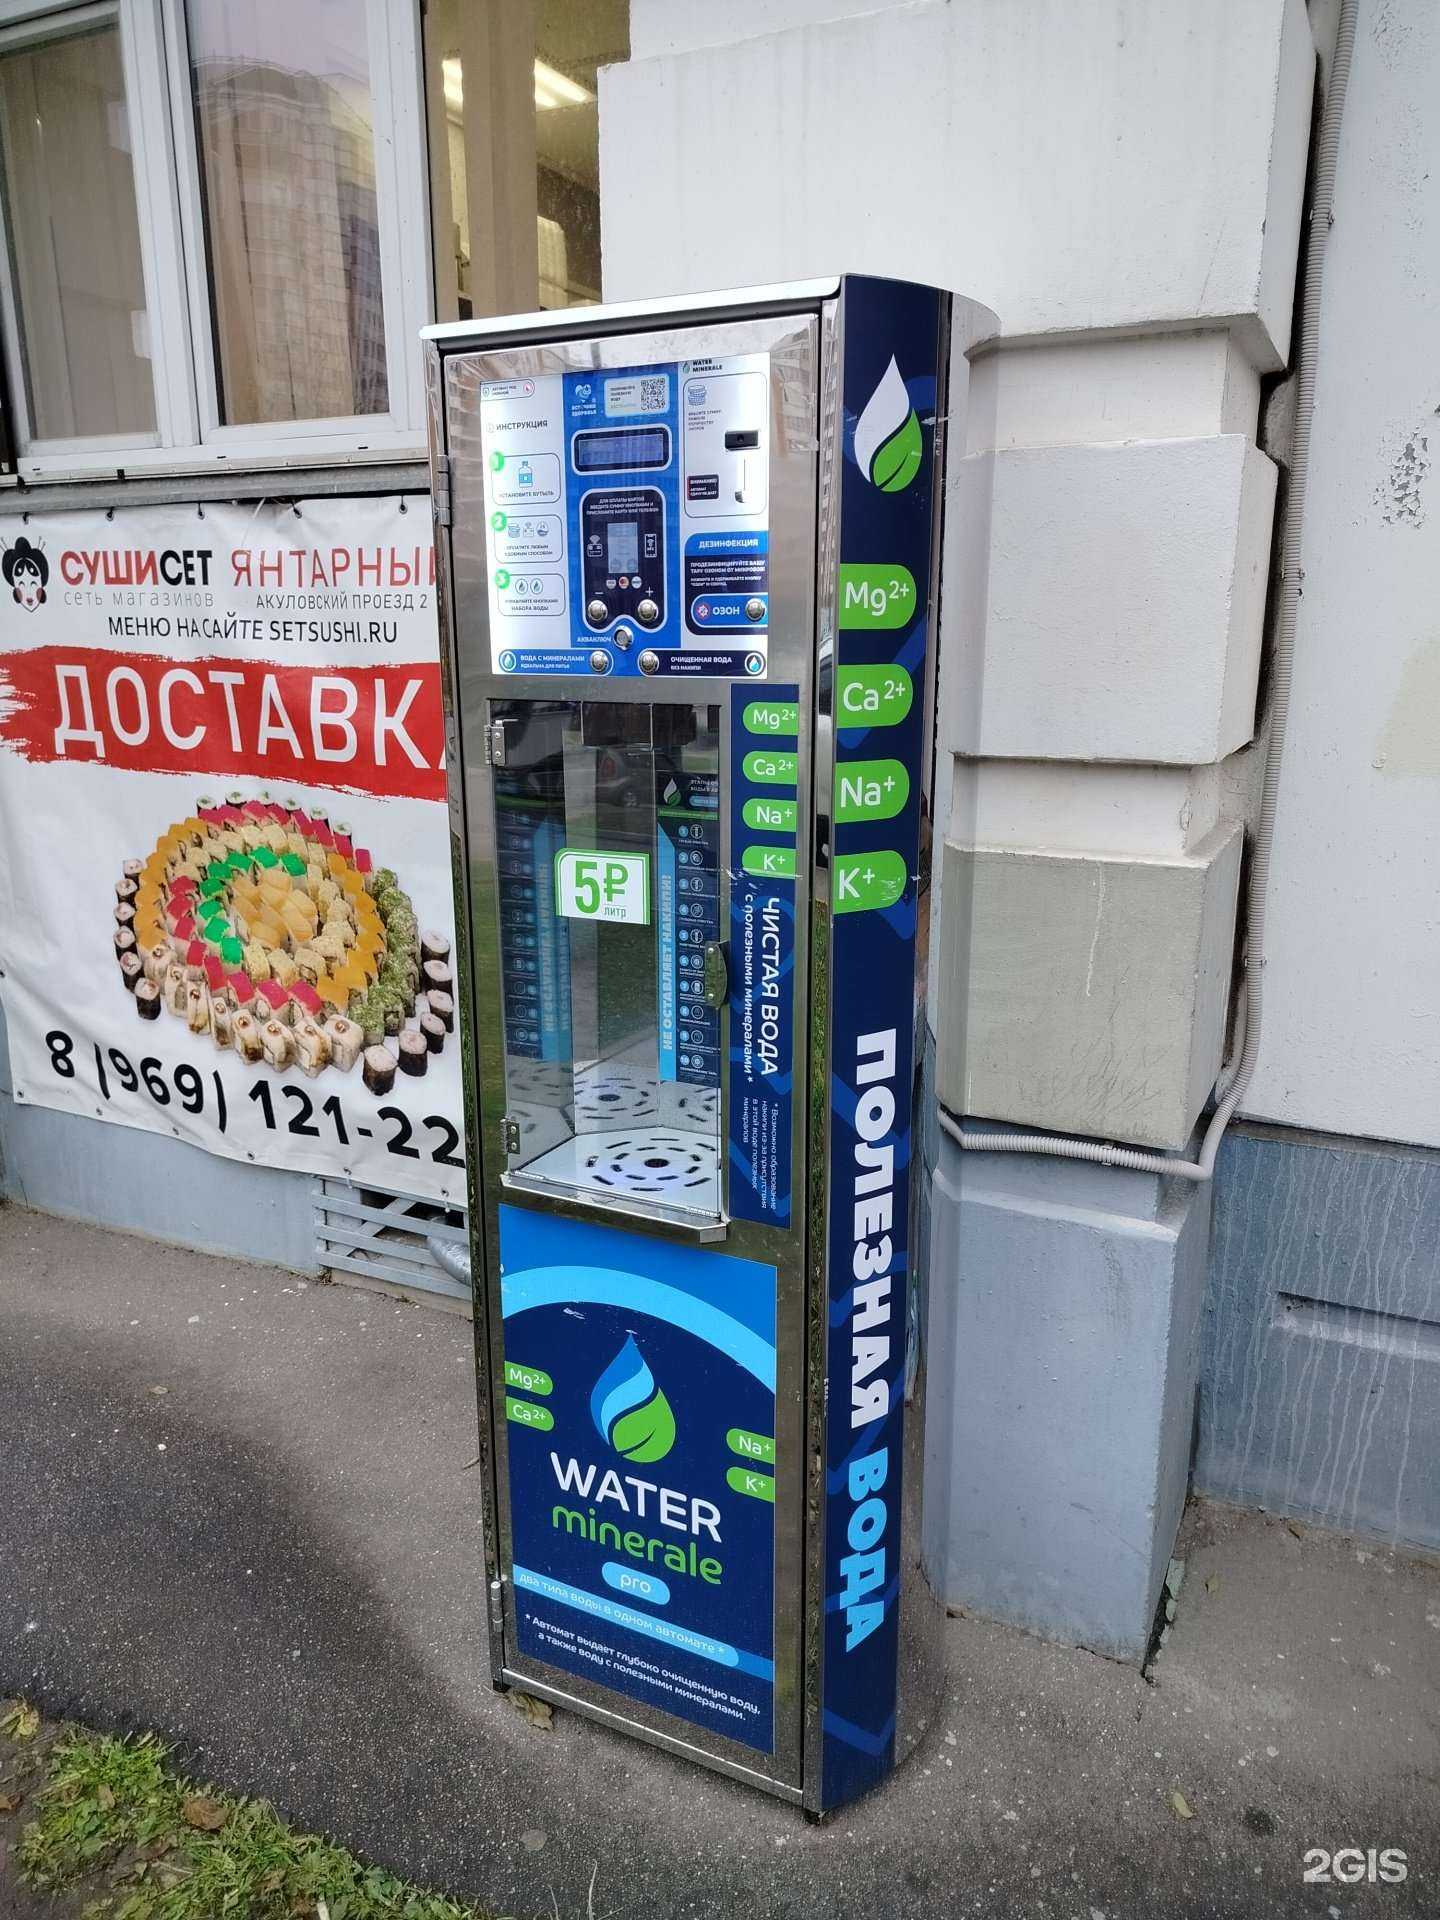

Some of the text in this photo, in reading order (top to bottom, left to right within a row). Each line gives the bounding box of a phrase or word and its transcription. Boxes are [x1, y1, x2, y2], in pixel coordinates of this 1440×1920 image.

[692, 365, 723, 373] MINERALE
[693, 358, 713, 366] WATER
[496, 419, 548, 431] ИНСТРУКЦИЯ
[699, 539, 759, 549] ДЕЗИНФЕКЦИЯ
[60, 549, 214, 586] СУШИСЕТ
[64, 592, 215, 608] сеть магазинов
[256, 590, 429, 612] АКУЛОВСКИЙ ПРОЕЗД 2
[713, 606, 740, 615] ОЗОН
[844, 580, 910, 617] Mg2+
[108, 616, 171, 637] МЕНЮ
[269, 620, 399, 644] SETSUSHI.RU
[670, 656, 733, 664] ОЧИЩЕННАЯ ВОДА
[843, 679, 907, 713] Ca2+
[54, 663, 447, 770] ДОСТАВК
[753, 709, 797, 730] Mg2+
[753, 759, 795, 777] Ca2+
[840, 775, 896, 808] Na+
[756, 806, 793, 825] Na+
[763, 853, 786, 871] K+
[838, 867, 876, 901] K+
[662, 944, 673, 1029] ОСТАВЛЯЕТ
[742, 894, 754, 1074] с полезными минералами
[757, 898, 780, 1076] ЧИСТАЯ ВОДА
[663, 1031, 673, 1050] НЕ
[45, 1031, 75, 1078] 8
[93, 1042, 228, 1134] (969)
[839, 1027, 897, 1653] ПОЛЕЗНАЯ ВОДА
[509, 1367, 546, 1390] Mg2+
[512, 1403, 547, 1424] Ca2+
[738, 1435, 772, 1456] Na+
[745, 1475, 767, 1493] K+
[550, 1451, 722, 1543] WATER
[552, 1504, 724, 1585] minerale
[619, 1572, 653, 1596] pro
[519, 1574, 715, 1654] два типа воды в одном автомате
[532, 1617, 761, 1715] Автомат выдает глубоко очищенную воду,
[538, 1632, 746, 1721] а также воду с полезными минералами.
